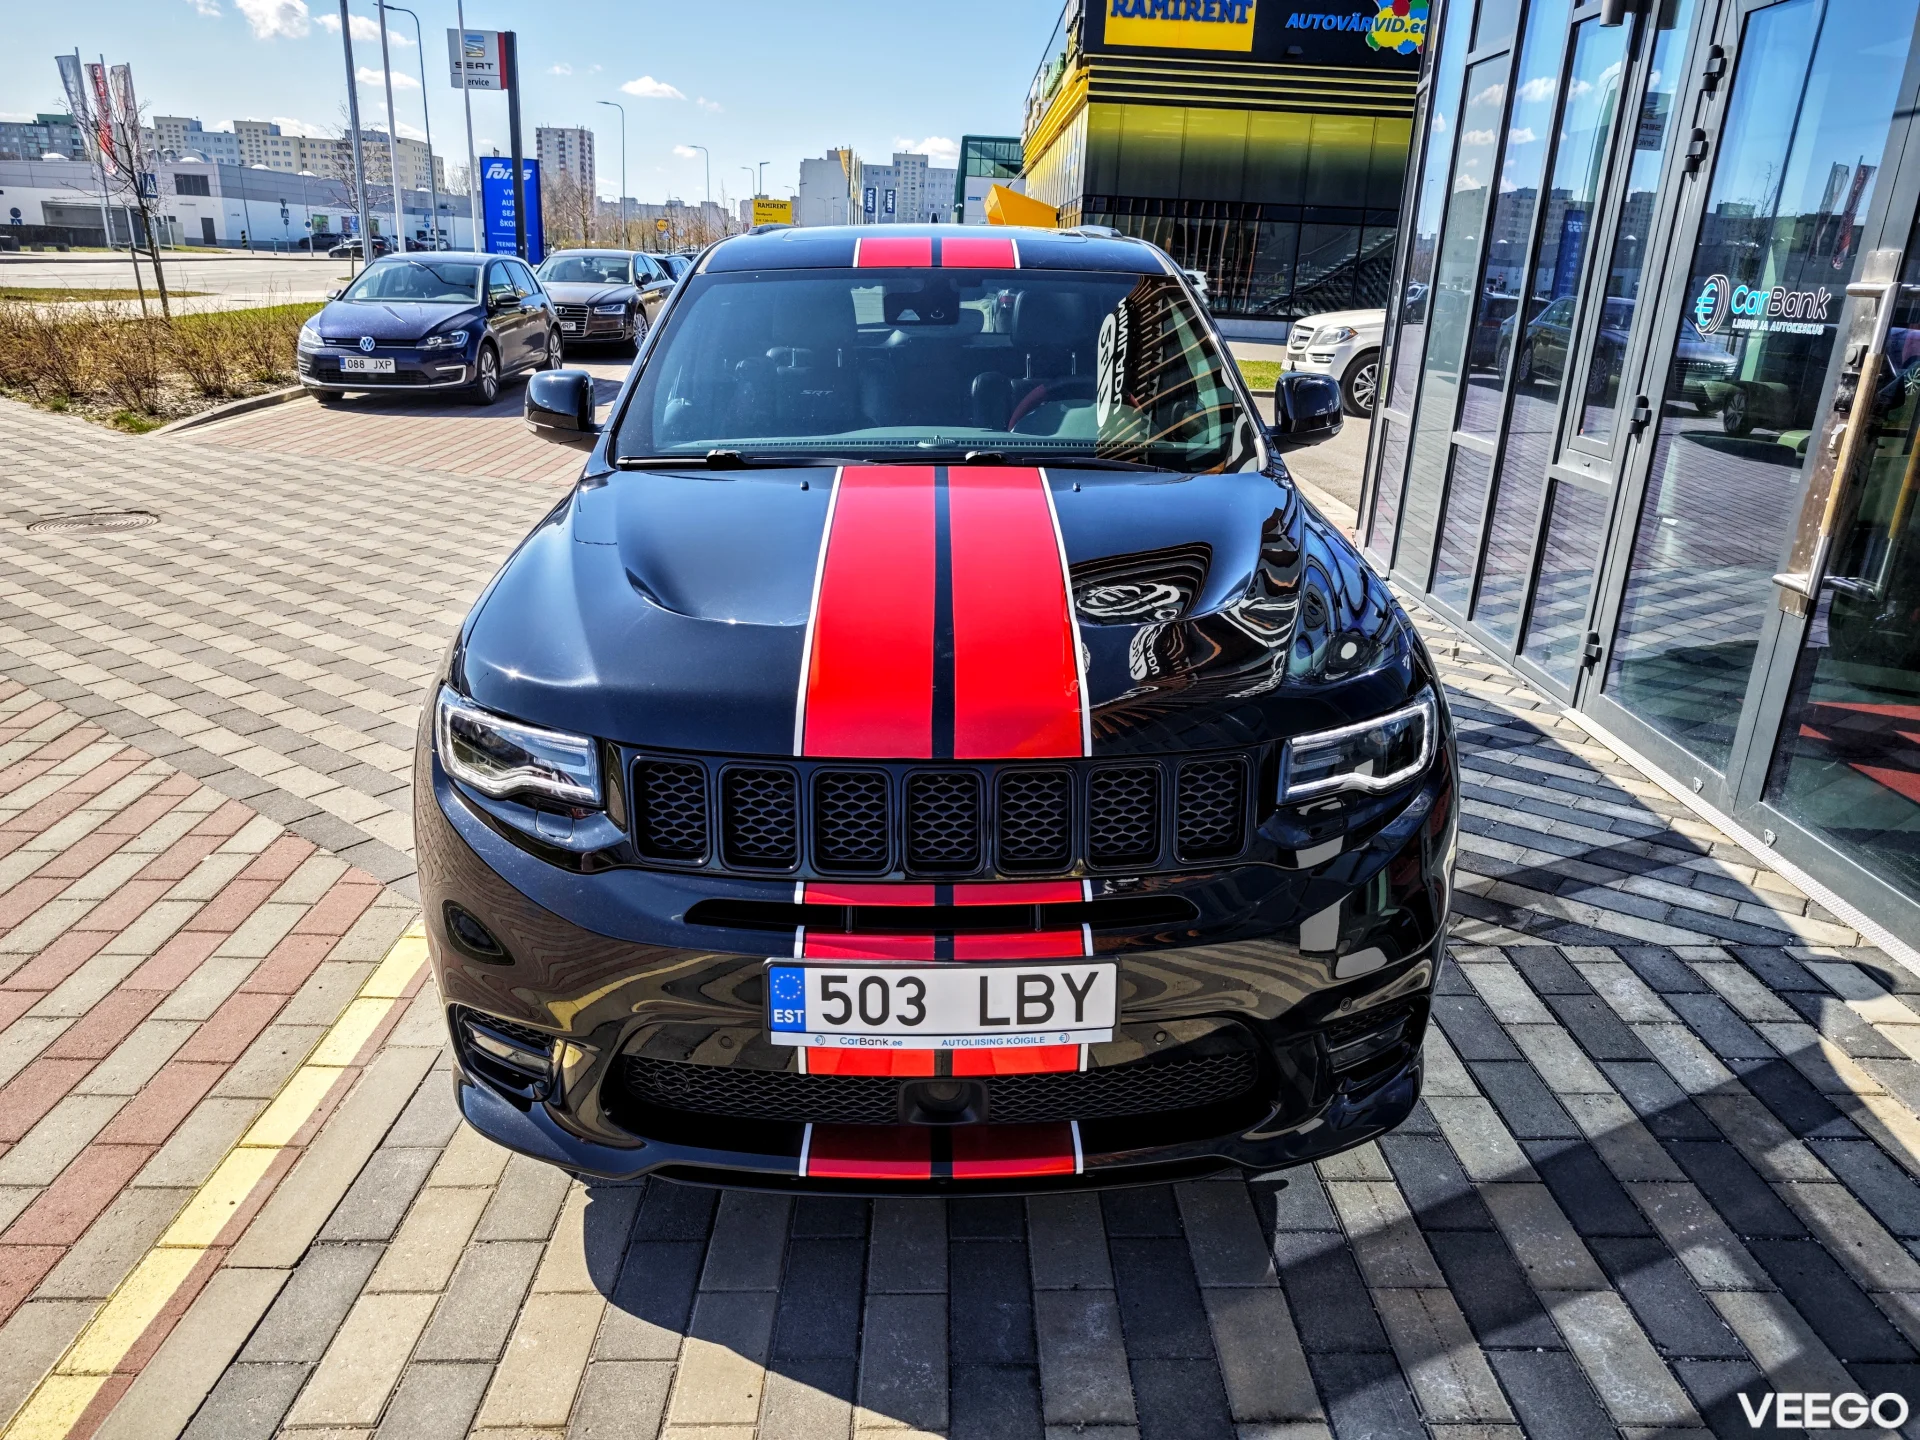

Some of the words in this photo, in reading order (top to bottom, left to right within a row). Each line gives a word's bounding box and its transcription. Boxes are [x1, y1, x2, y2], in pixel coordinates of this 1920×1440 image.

[1110, 0, 1253, 24] RAMIRENT
[467, 78, 490, 86] ervice
[757, 202, 788, 210] RAMIRENT
[1731, 284, 1832, 320] CarBank
[1759, 320, 1769, 331] JA
[1770, 322, 1825, 336] AUTOKESKUS
[347, 359, 365, 369] 088
[373, 360, 392, 370] JXP
[800, 389, 834, 397] SRT
[773, 1009, 804, 1024] EST
[821, 975, 927, 1026] 503
[979, 971, 1099, 1027] LBY
[941, 1037, 1004, 1047] AUTOLIISING
[1006, 1036, 1045, 1045] KÕIGILE
